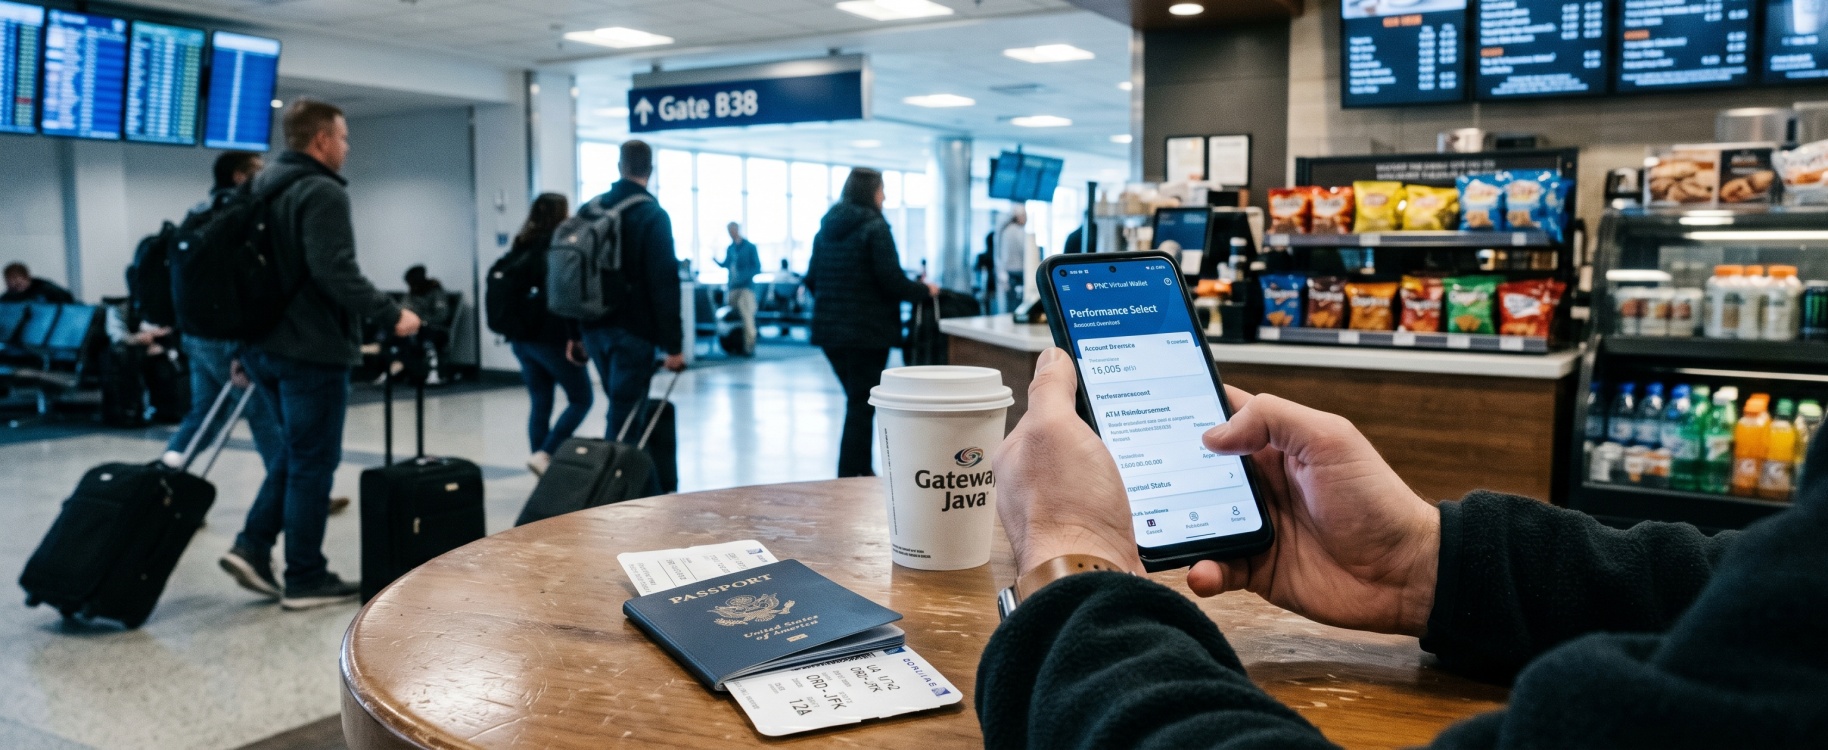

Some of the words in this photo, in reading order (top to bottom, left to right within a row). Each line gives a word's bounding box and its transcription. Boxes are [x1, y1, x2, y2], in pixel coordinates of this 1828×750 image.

[658, 94, 709, 122] Gate
[715, 88, 758, 119] B38
[1094, 282, 1109, 290] PNC
[1109, 280, 1129, 289] Virtual
[1128, 280, 1148, 288] Wallet
[1069, 305, 1128, 318] Performance
[1129, 303, 1158, 315] Select
[1084, 344, 1108, 352] Account
[1091, 364, 1121, 376] 16,005
[1105, 410, 1121, 418] ATM
[1151, 480, 1172, 490] Status
[941, 491, 986, 513] Java
[668, 573, 772, 604] PASSPORT
[756, 632, 770, 642] of
[806, 673, 848, 711] ORD-JFK
[789, 698, 812, 717] 12A
